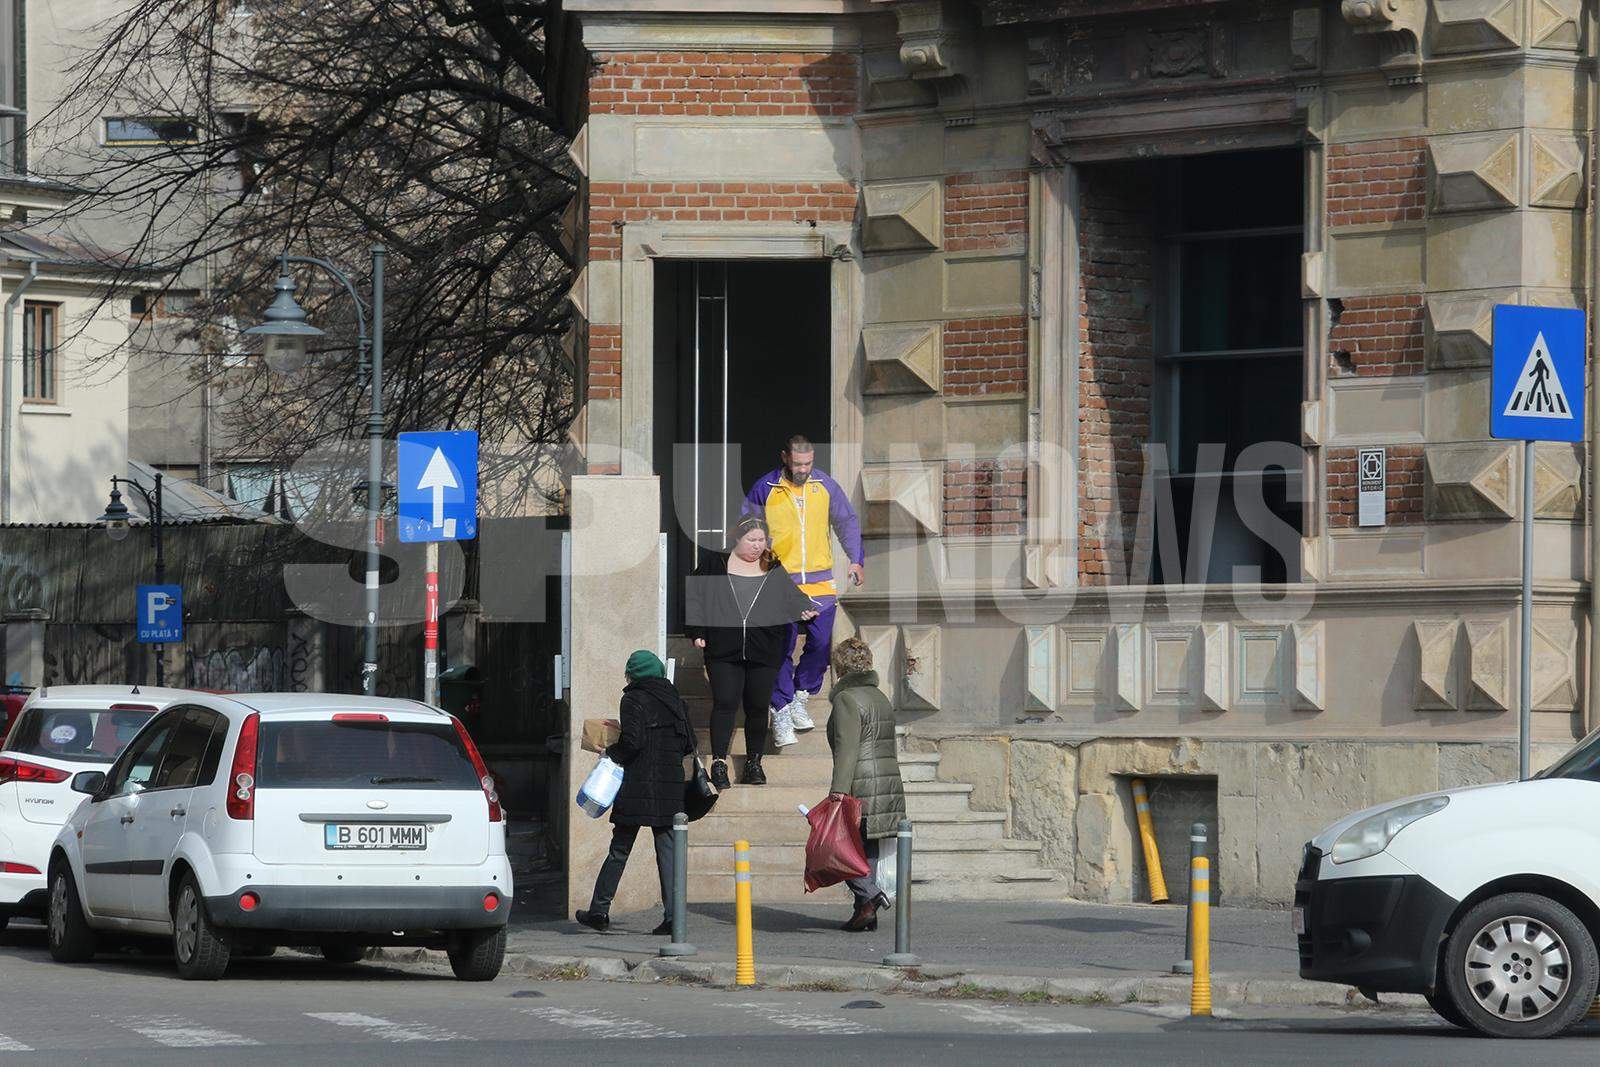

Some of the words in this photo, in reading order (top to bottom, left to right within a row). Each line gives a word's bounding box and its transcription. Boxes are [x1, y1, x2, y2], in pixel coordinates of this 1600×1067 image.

[147, 592, 170, 624] P
[339, 827, 351, 843] B
[358, 827, 384, 843] 601
[390, 827, 422, 844] MMM
